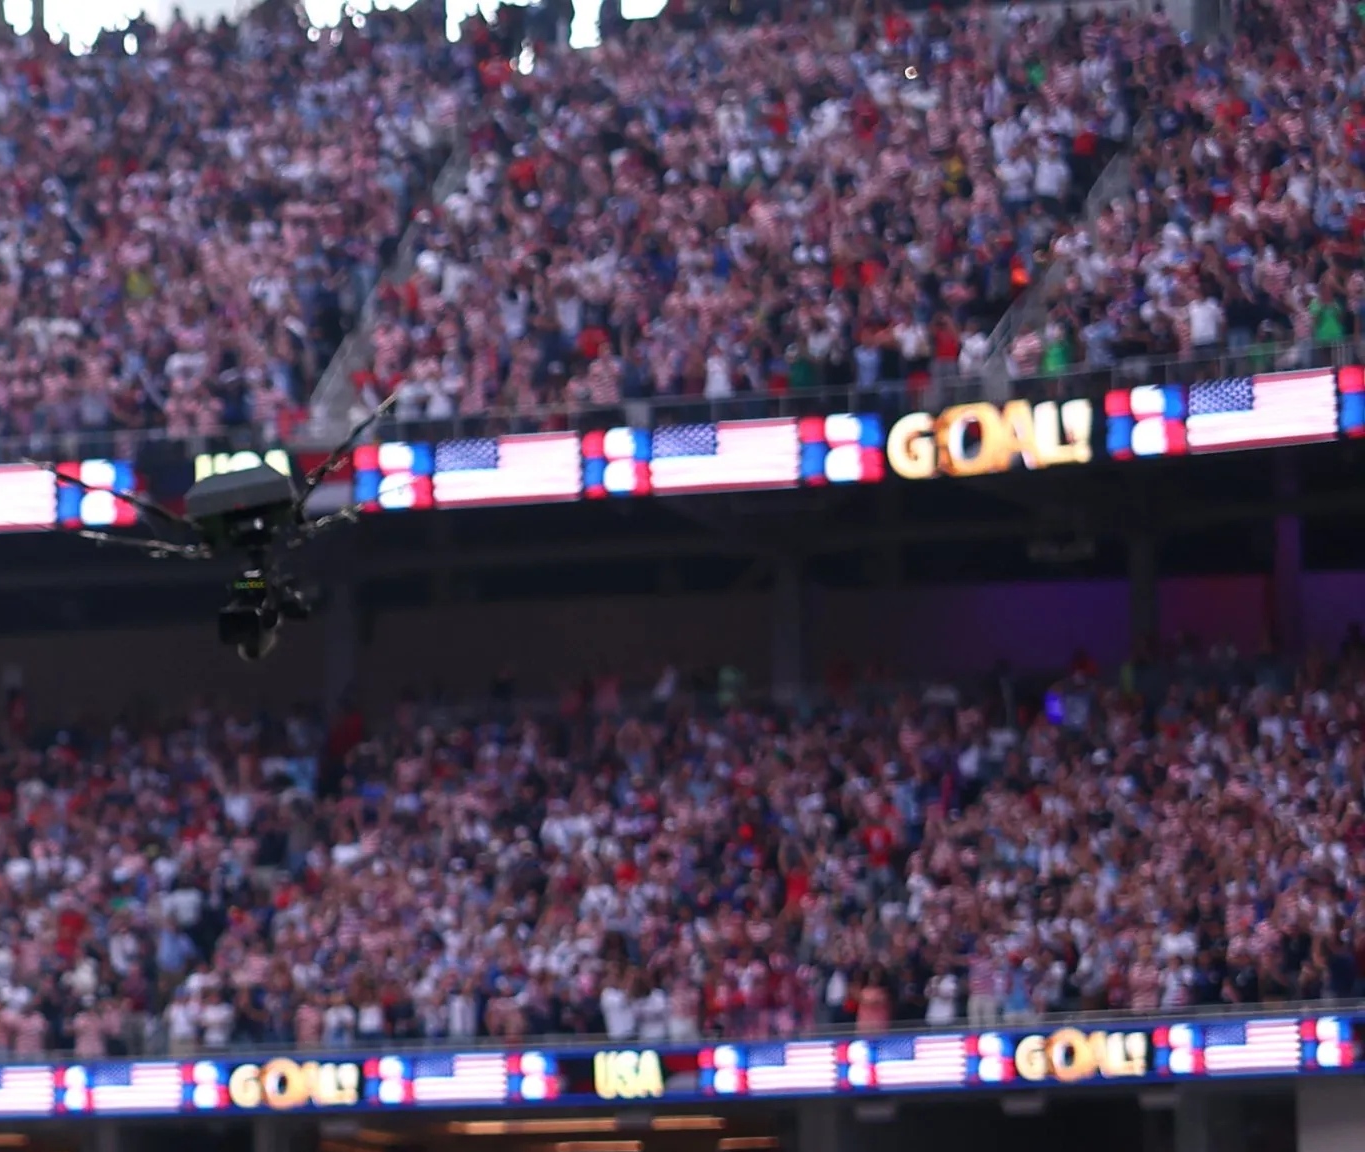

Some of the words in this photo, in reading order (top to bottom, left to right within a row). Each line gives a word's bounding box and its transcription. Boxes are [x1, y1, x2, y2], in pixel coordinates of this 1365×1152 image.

[886, 397, 1094, 481] GOAL!
[592, 1050, 664, 1099] USA
[1015, 1028, 1147, 1084] GOAL!
[229, 1057, 359, 1110] GOAL!
